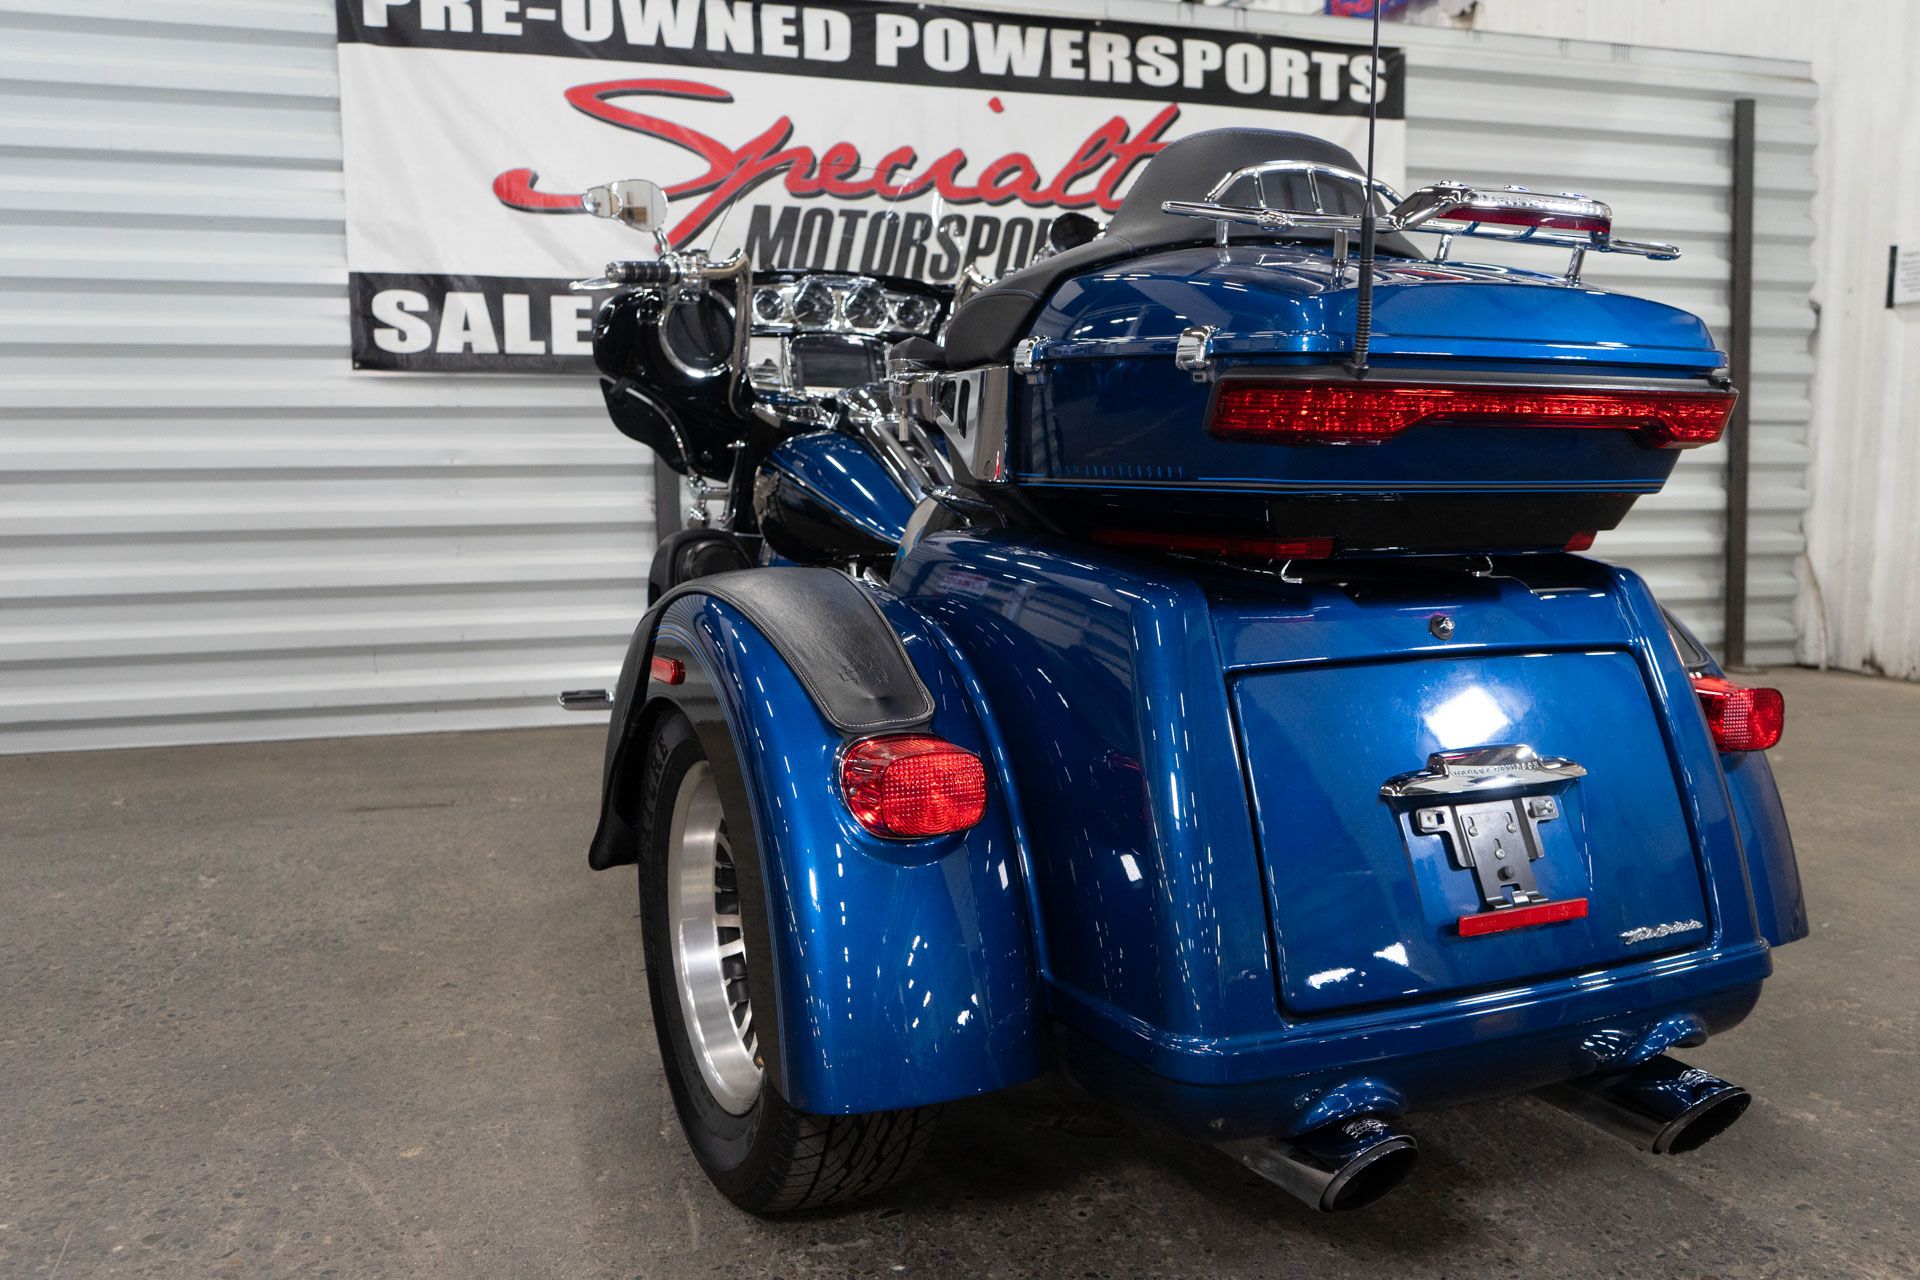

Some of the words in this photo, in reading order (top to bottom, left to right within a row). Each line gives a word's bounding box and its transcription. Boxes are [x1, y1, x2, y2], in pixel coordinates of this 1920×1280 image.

[362, 0, 852, 62] PRE-OWNED
[875, 12, 1387, 105] POWERSPORTS
[493, 78, 1181, 253] Specialt
